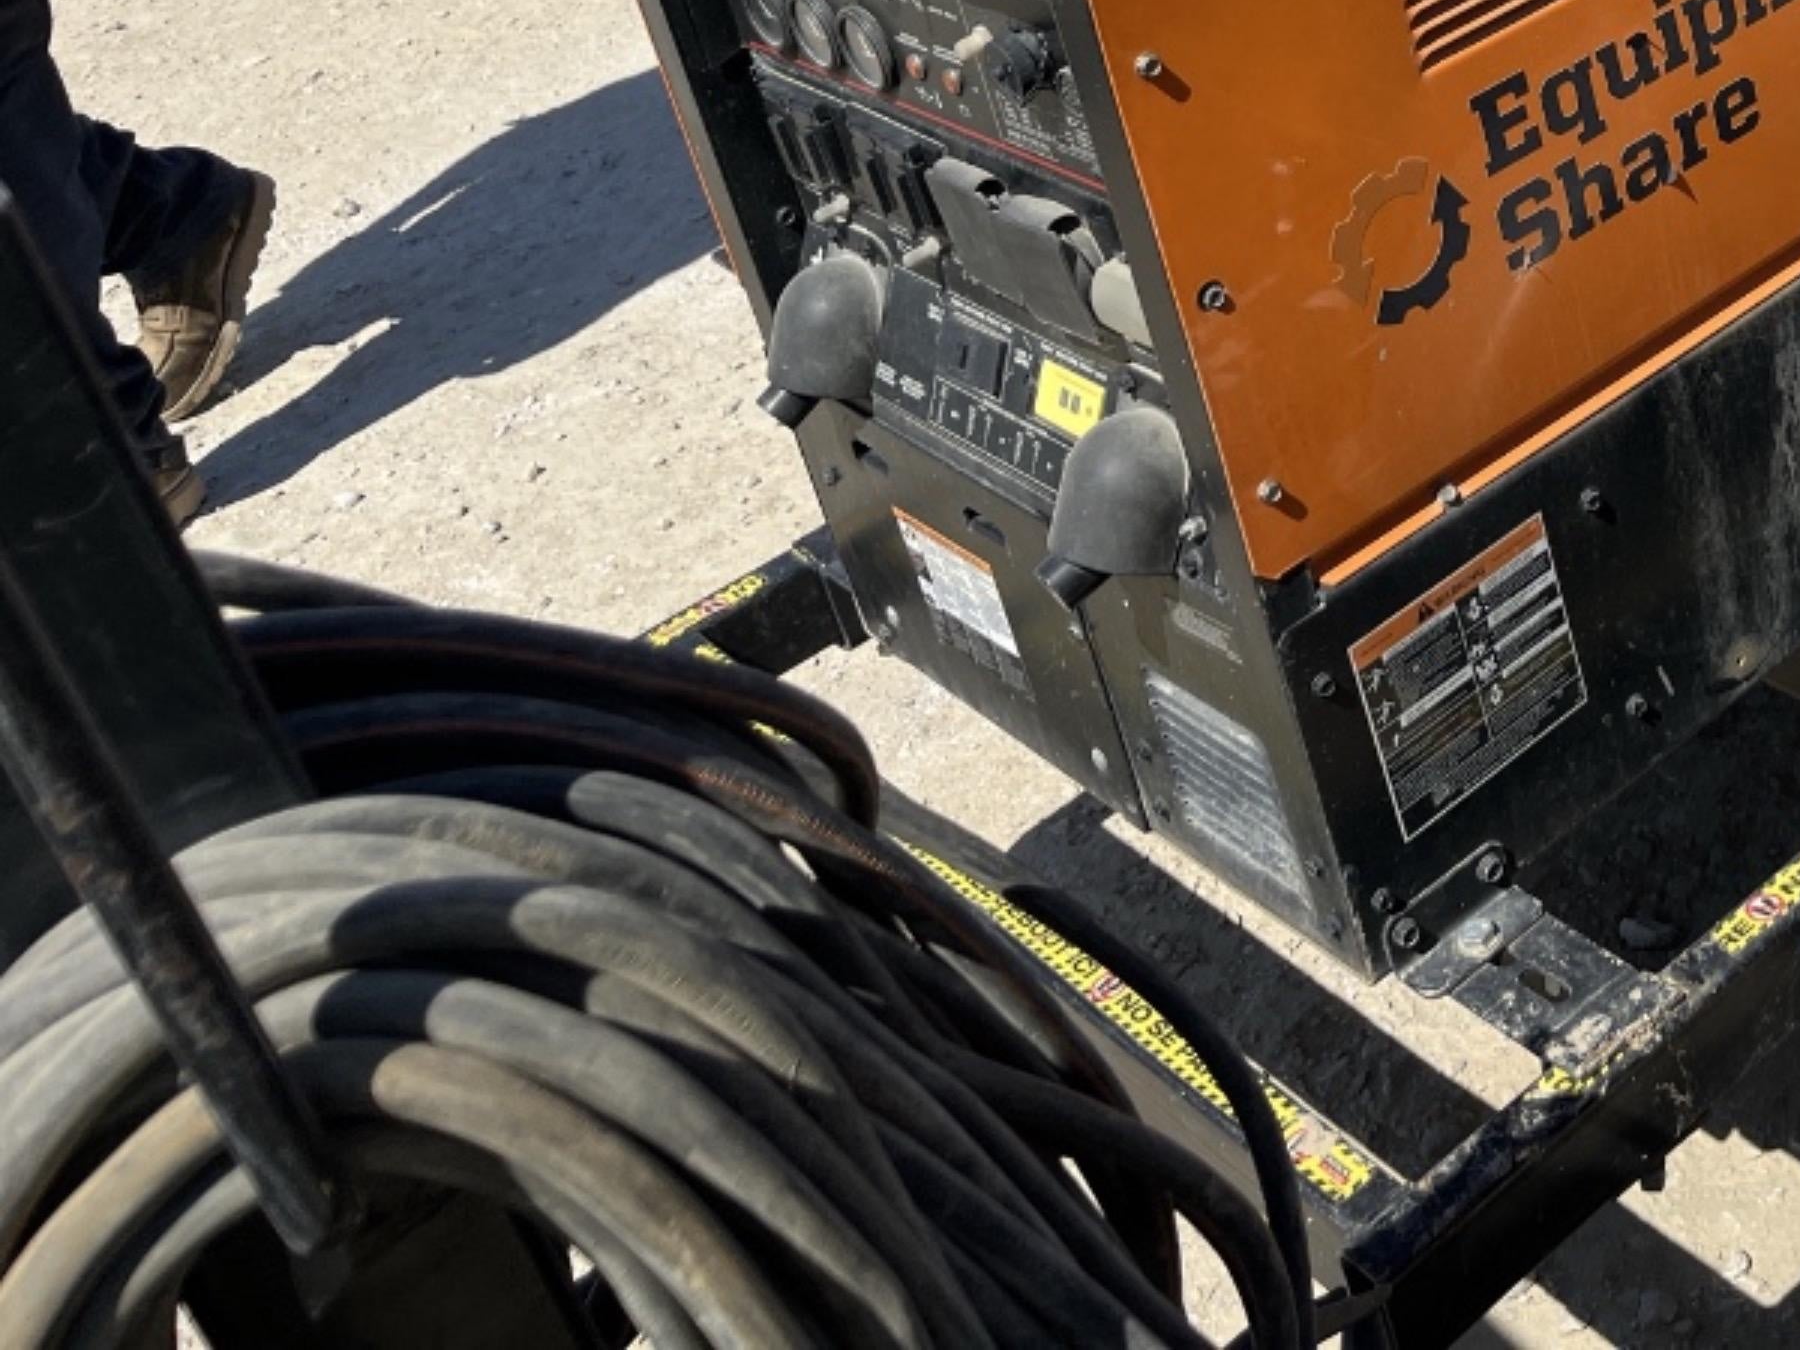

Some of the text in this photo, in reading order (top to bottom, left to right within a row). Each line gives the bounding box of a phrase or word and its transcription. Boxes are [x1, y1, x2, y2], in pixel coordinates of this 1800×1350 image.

[1495, 74, 1764, 272] Share
[1115, 993, 1154, 1023] NO
[1148, 1019, 1178, 1050] SE
